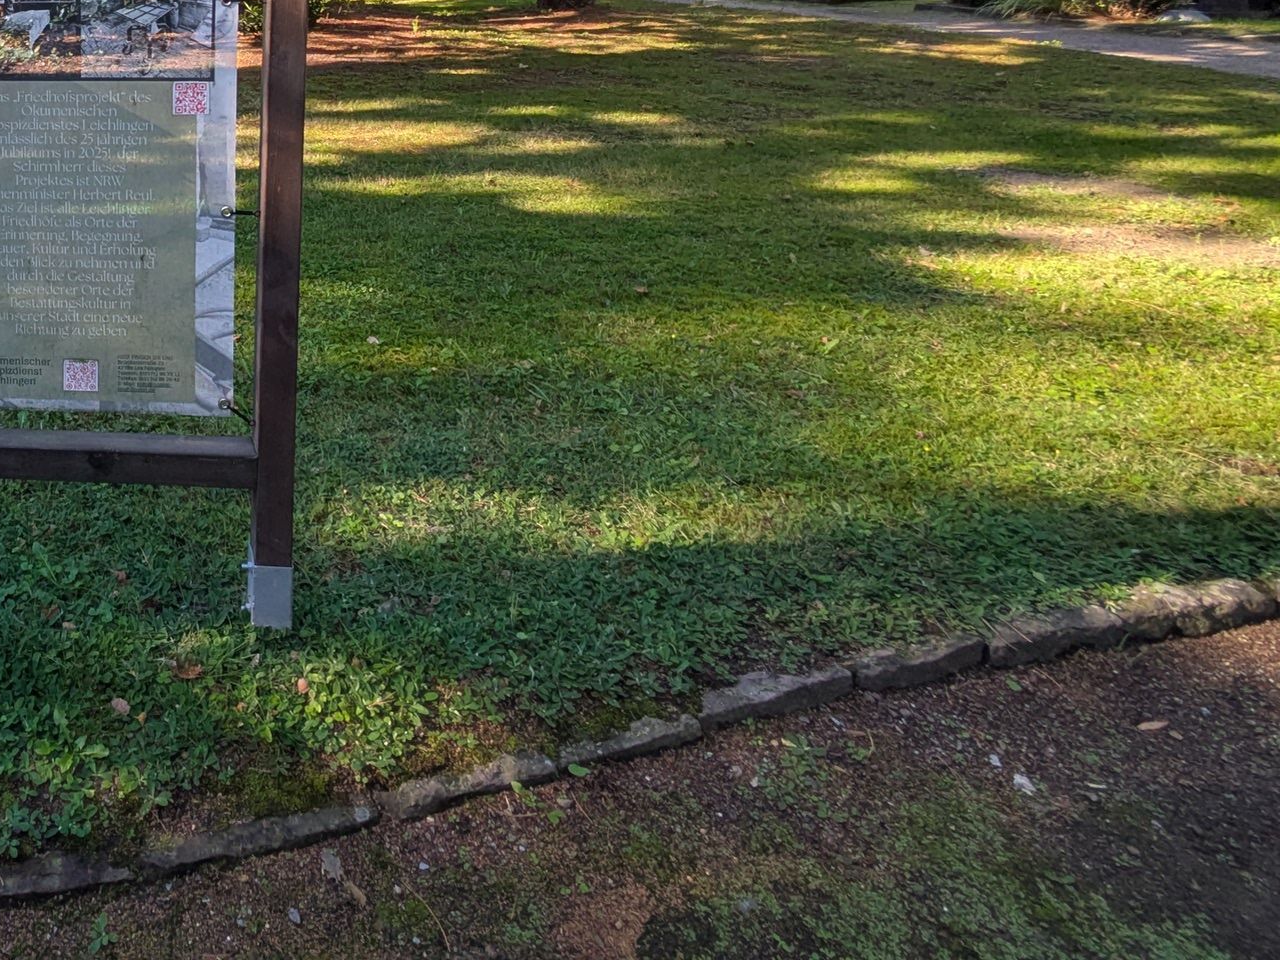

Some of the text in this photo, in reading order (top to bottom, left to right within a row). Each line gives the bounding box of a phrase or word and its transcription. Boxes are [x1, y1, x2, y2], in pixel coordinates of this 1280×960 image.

[129, 91, 151, 103] des
[21, 104, 117, 117] Ökumenischen
[82, 119, 153, 135] Leichlingen
[55, 133, 77, 144] des
[80, 133, 93, 145] 25
[97, 133, 147, 147] jährigen
[0, 146, 61, 159] Jubiläums
[64, 147, 75, 158] in
[117, 146, 138, 159] der
[13, 160, 127, 173] Schirmherr dieses
[16, 175, 124, 188] Projektes ist NRW
[73, 189, 121, 200] Herbert
[16, 202, 37, 213] Ziel
[41, 202, 54, 213] ist
[57, 202, 79, 213] alle
[2, 215, 137, 228] Friedhöfe als Orte der
[32, 243, 69, 255] Kultur
[73, 244, 97, 255] und
[100, 244, 157, 257] Erholung
[0, 256, 23, 267] den
[28, 256, 58, 267] Blick
[59, 259, 72, 268] zu
[76, 258, 127, 269] nehmen
[130, 258, 154, 269] und
[7, 269, 135, 285] durch die Gestaltung
[7, 284, 134, 296] besonderer Orte der
[10, 298, 131, 312] Bestattungskultur in
[48, 311, 79, 322] Stadt
[83, 312, 109, 323] eine
[112, 313, 143, 323] neue
[15, 324, 127, 339] Richtung zu geben
